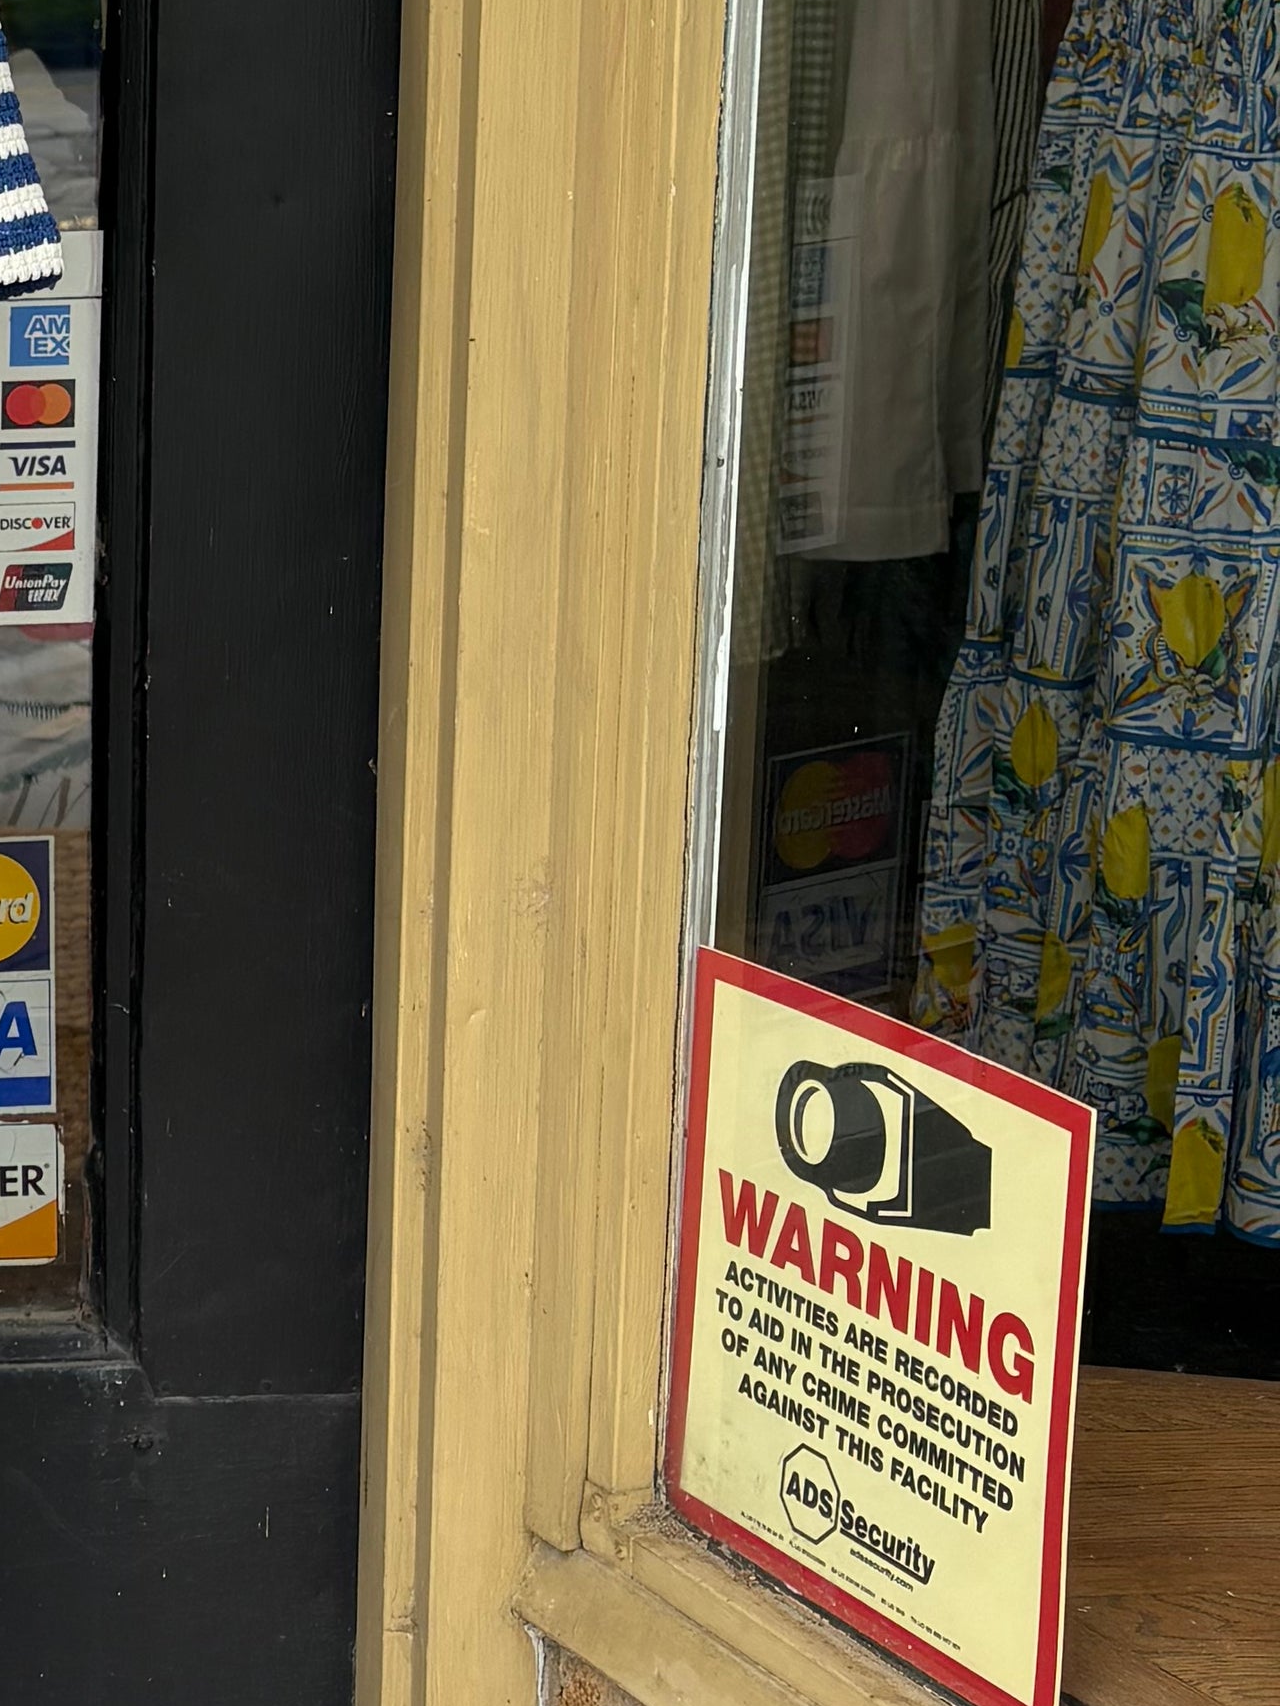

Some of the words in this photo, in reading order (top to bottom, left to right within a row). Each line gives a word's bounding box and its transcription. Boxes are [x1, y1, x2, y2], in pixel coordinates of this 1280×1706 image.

[24, 314, 71, 337] AM
[30, 336, 70, 357] EX
[8, 454, 67, 477] VISA
[0, 515, 72, 531] DISCOVER
[4, 574, 67, 598] UnionPay
[718, 1168, 1035, 1405] WARNING
[715, 1287, 743, 1322] TO
[748, 1307, 785, 1343] AID
[790, 1328, 813, 1360] IN
[819, 1342, 861, 1387] THE
[867, 1369, 1026, 1483] PROSECUTION
[725, 1260, 839, 1337] ACTIVITIES
[844, 1322, 889, 1365] ARE
[894, 1347, 1019, 1437] RECORDED
[721, 1327, 749, 1358] OF
[753, 1346, 797, 1385] ANY
[802, 1371, 871, 1430] CRIME
[877, 1413, 1014, 1512] COMMITTED
[738, 1373, 830, 1440] AGAINST
[835, 1425, 884, 1473] THIS
[890, 1456, 989, 1534] FACILITY
[786, 1471, 834, 1520] ADS
[840, 1499, 936, 1580] Security
